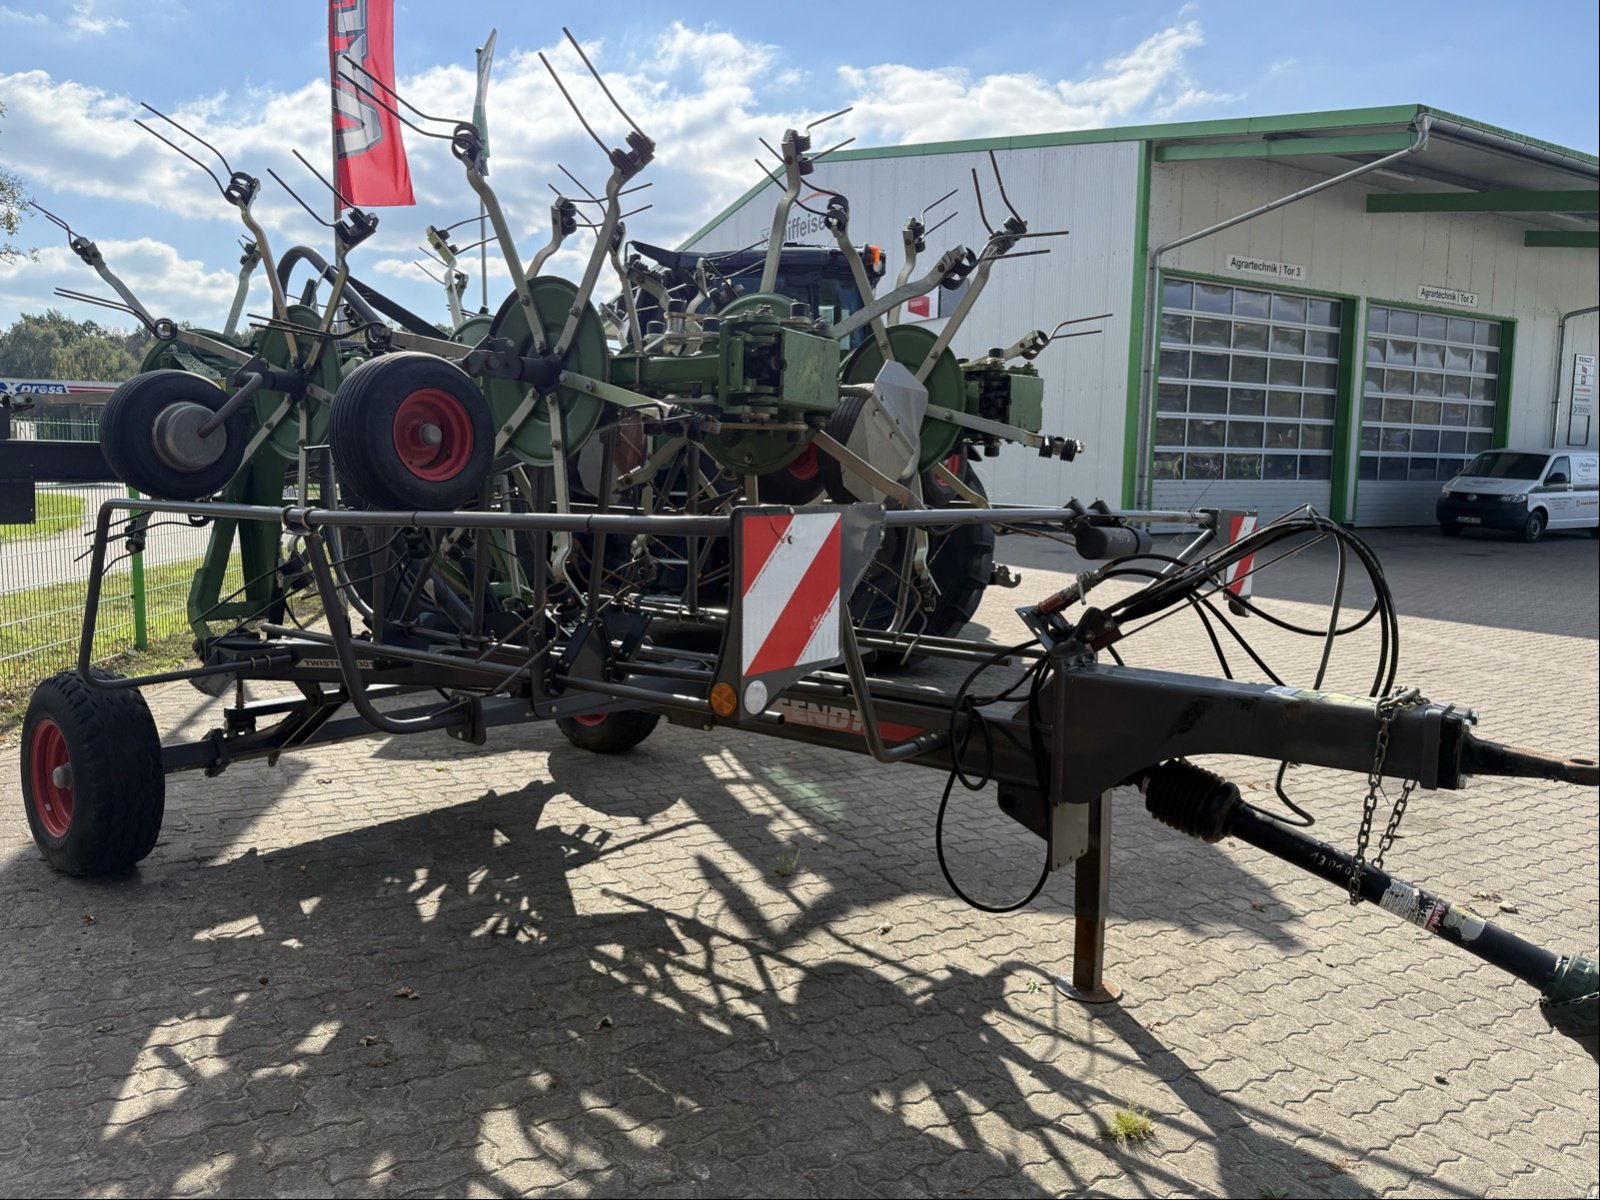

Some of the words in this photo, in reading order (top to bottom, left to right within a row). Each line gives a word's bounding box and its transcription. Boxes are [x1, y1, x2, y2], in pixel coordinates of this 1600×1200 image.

[1230, 257, 1278, 274] Agrartechnik
[1283, 265, 1295, 276] Tor
[1295, 267, 1301, 277] 3
[1420, 287, 1457, 302] Agrartechnik
[1460, 293, 1470, 304] Tor
[1470, 295, 1475, 304] 2
[303, 659, 341, 668] TWISTE
